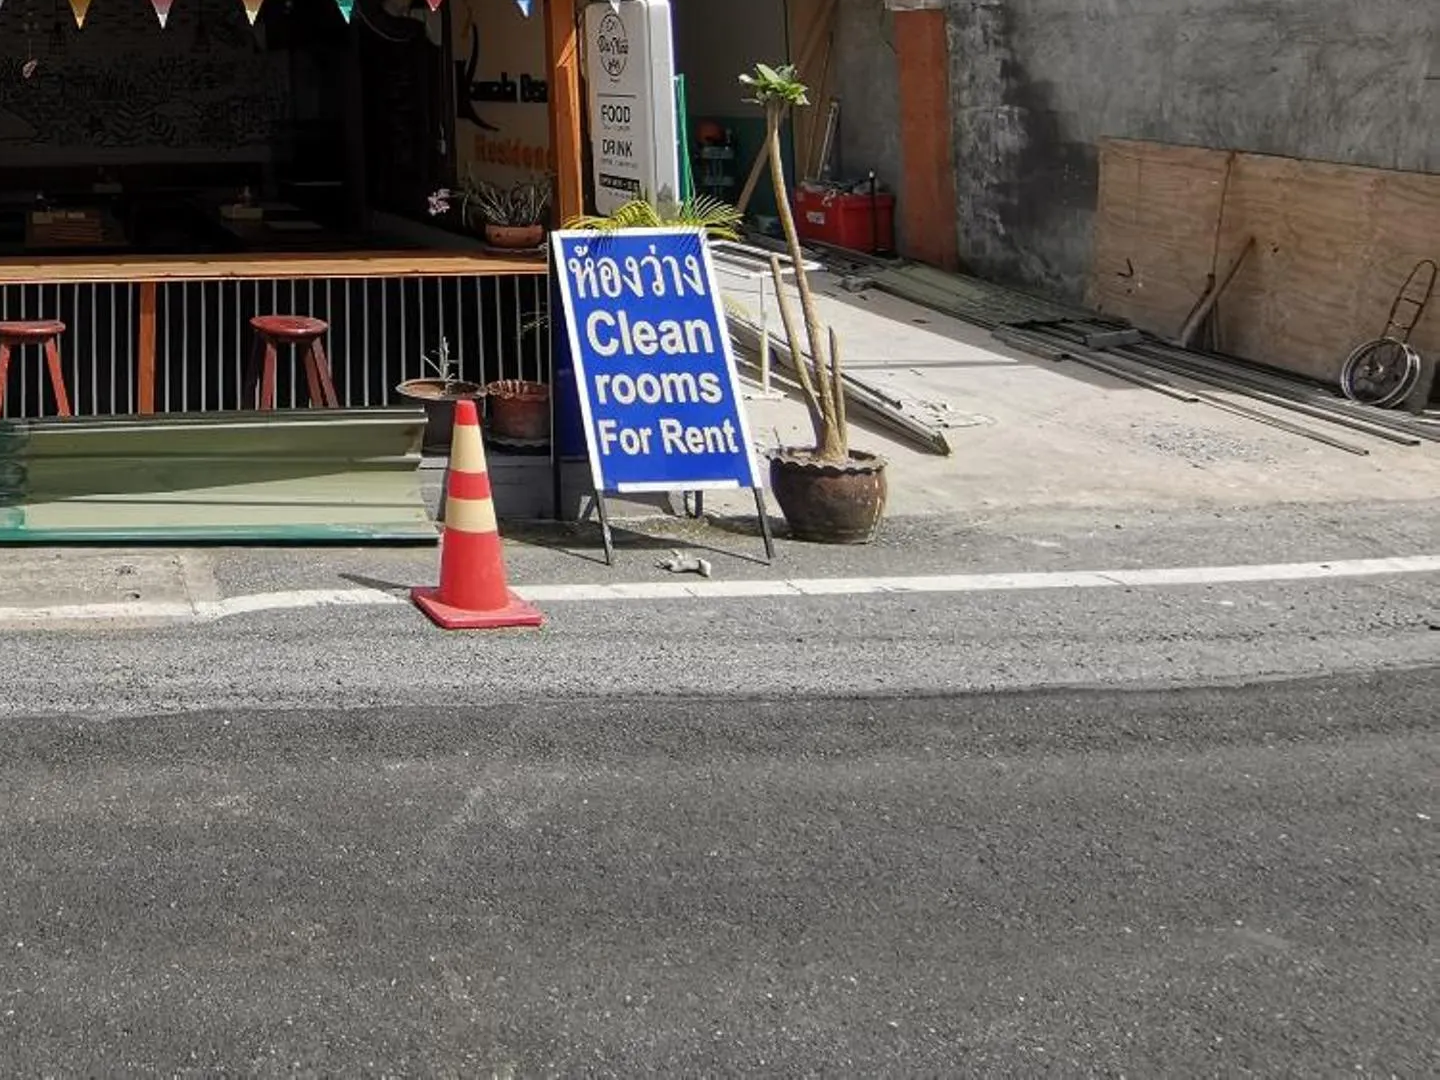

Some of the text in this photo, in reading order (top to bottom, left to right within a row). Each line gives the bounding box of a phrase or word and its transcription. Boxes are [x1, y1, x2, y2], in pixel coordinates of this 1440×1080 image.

[601, 104, 631, 124] FOOD
[602, 139, 633, 158] DRINK
[567, 244, 706, 299] ห้องว่าง
[586, 309, 715, 357] Clean
[594, 372, 723, 405] rooms
[598, 418, 740, 455] For Rent
